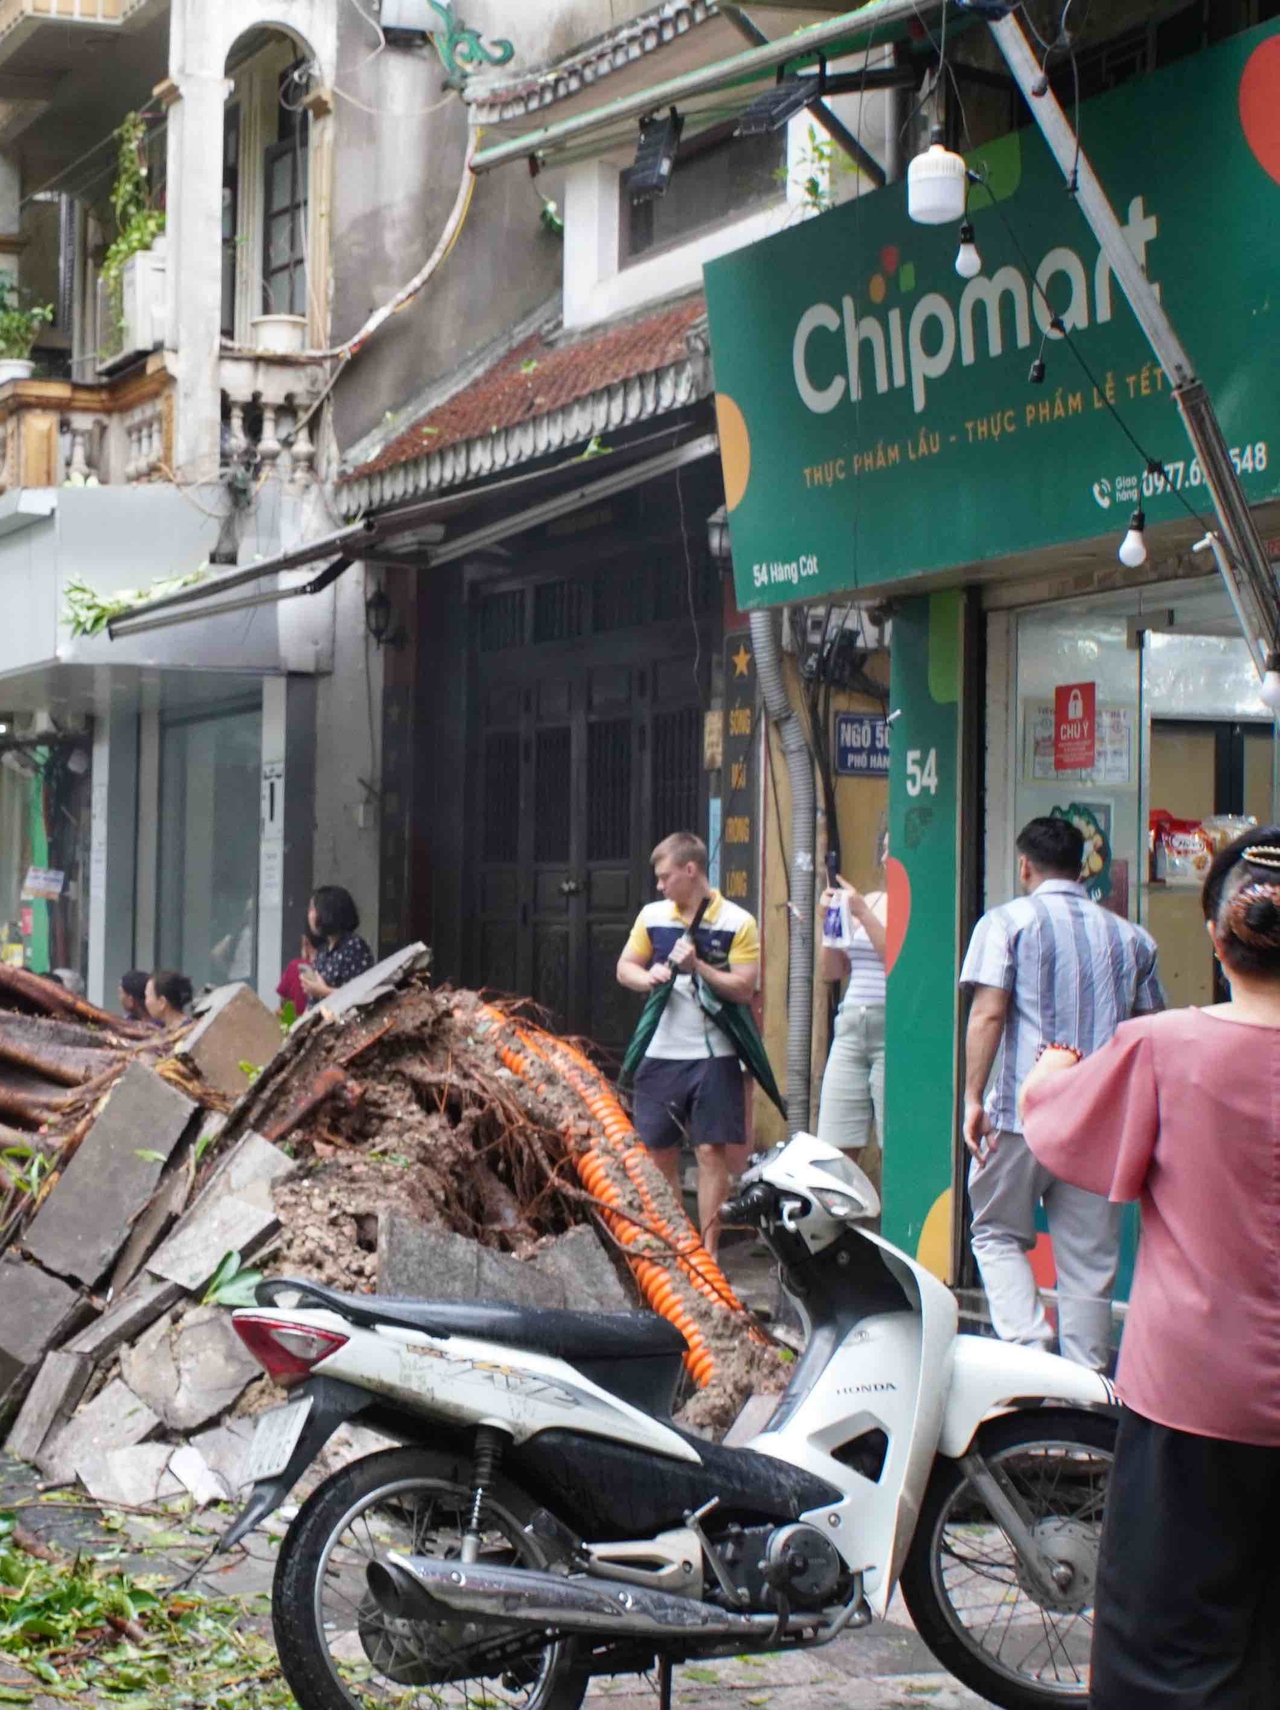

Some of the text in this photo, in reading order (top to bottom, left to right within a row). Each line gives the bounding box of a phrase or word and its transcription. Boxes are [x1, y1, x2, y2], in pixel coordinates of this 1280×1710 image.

[793, 195, 1160, 414] Chipmart
[965, 409, 1017, 443] THỰC
[1093, 371, 1116, 410] LỄ
[1126, 361, 1165, 399] TẾT
[1115, 475, 1138, 489] Giao
[752, 562, 769, 588] 54
[769, 561, 799, 585] Hàng
[840, 720, 872, 748] NGÕ
[847, 751, 868, 769] PHỐ
[905, 747, 938, 797] 54
[836, 1382, 897, 1396] HONDA
